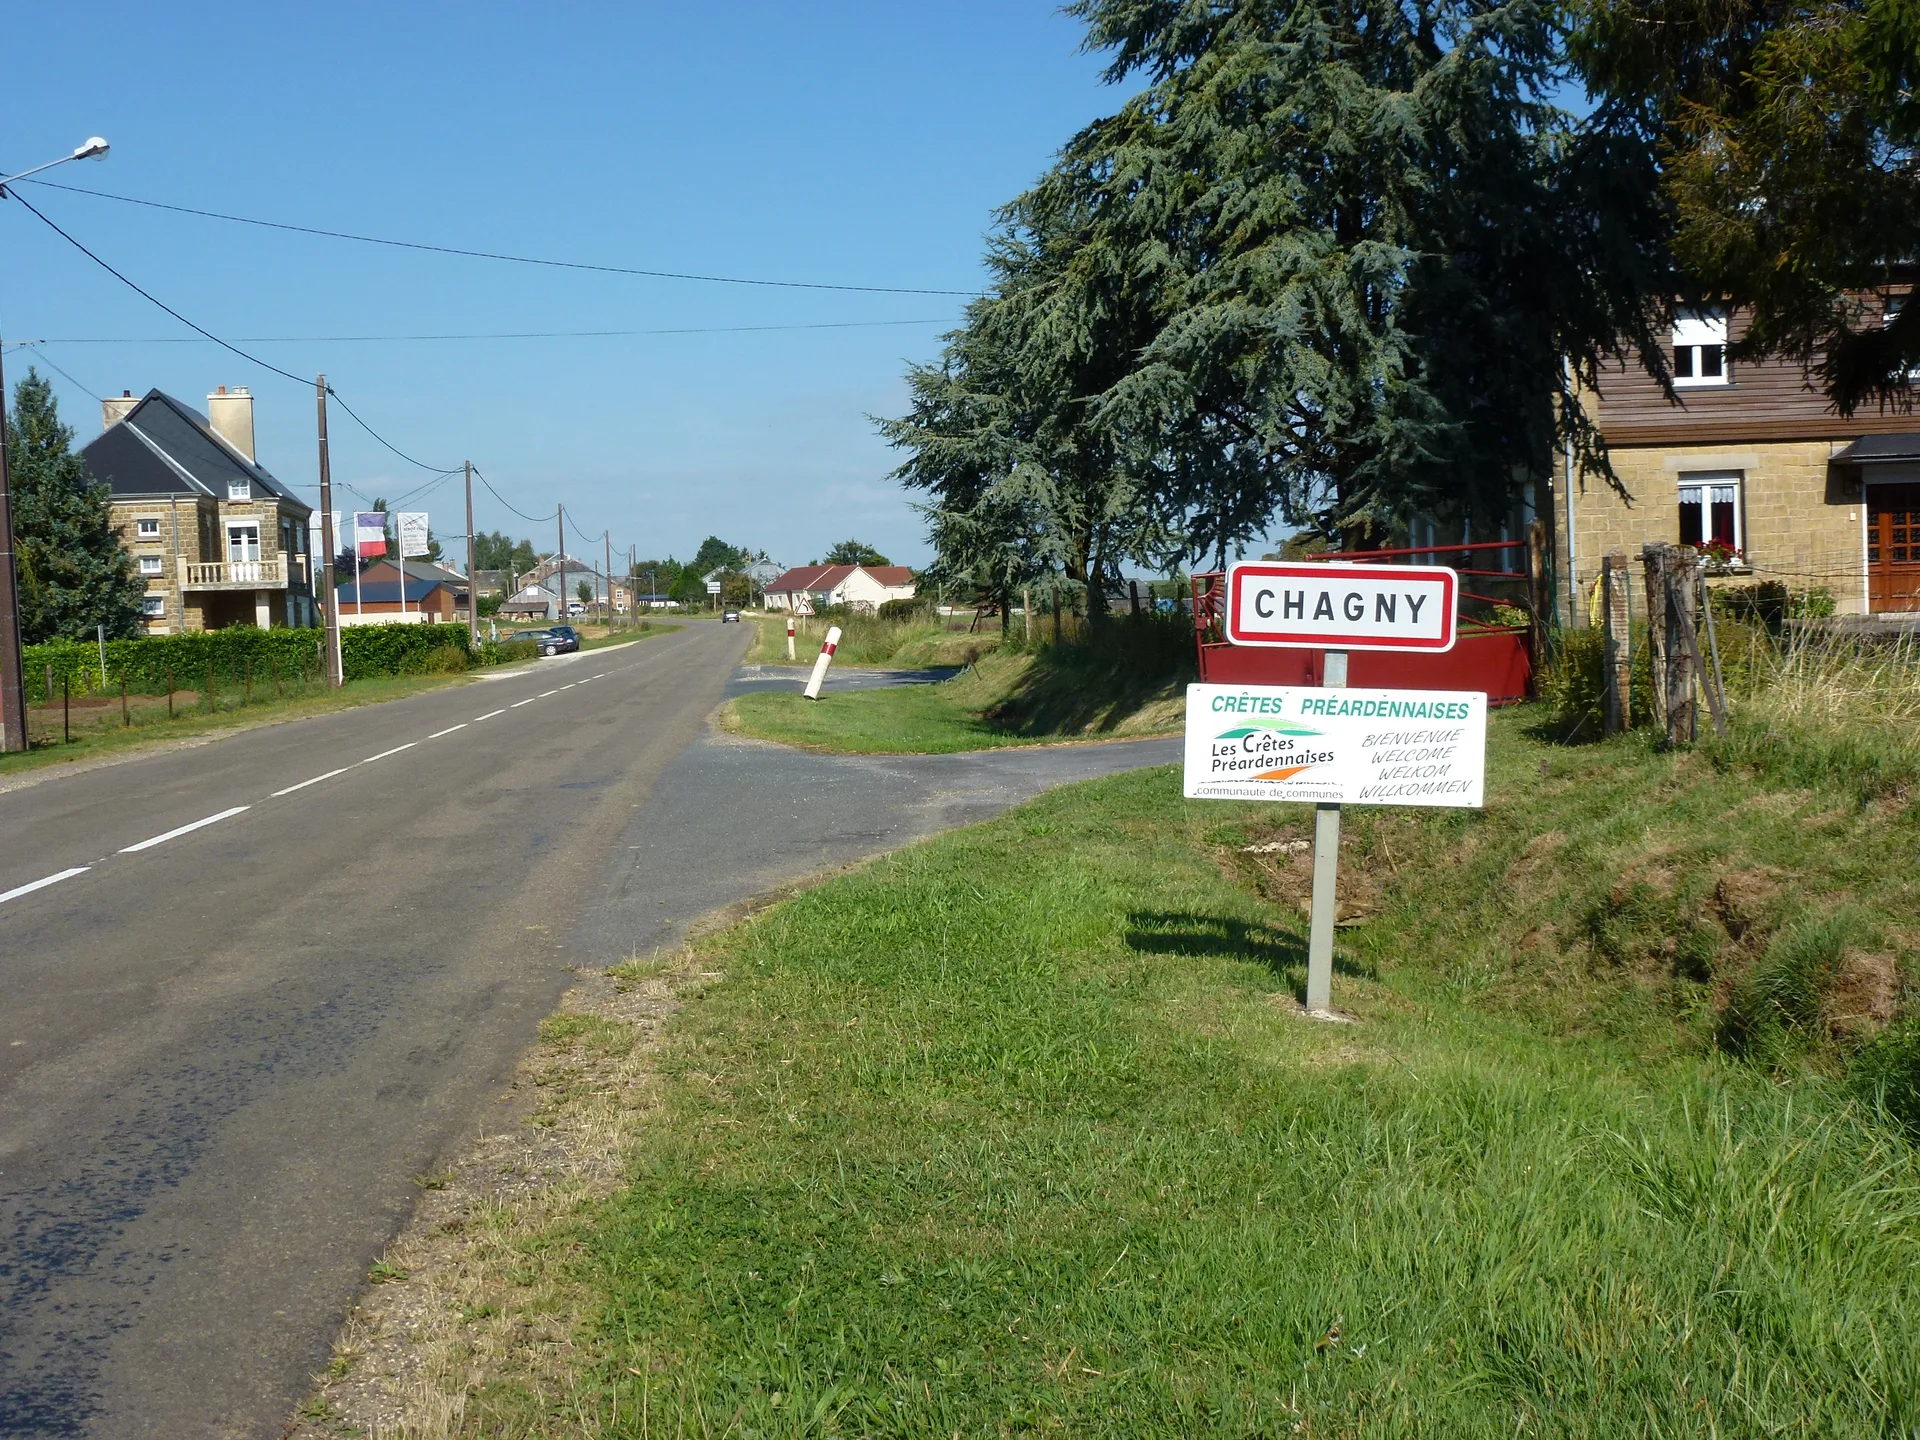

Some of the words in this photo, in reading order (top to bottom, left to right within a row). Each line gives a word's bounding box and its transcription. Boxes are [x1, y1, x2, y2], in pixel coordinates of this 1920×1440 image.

[1255, 589, 1427, 623] CHAGNY
[1212, 692, 1283, 714] CRÊTES
[1300, 695, 1470, 719] PRÉARDENNAISES
[1212, 744, 1236, 757] Les
[1243, 734, 1294, 753] Crêtes
[1361, 728, 1465, 747] BIENVENUE
[1212, 749, 1334, 772] Préardennaises
[1371, 746, 1457, 764] WELCOME
[1378, 764, 1451, 780] WELKOM
[1269, 788, 1283, 797] de
[1286, 789, 1344, 799] communes
[1359, 780, 1472, 799] WILLKOMMEN
